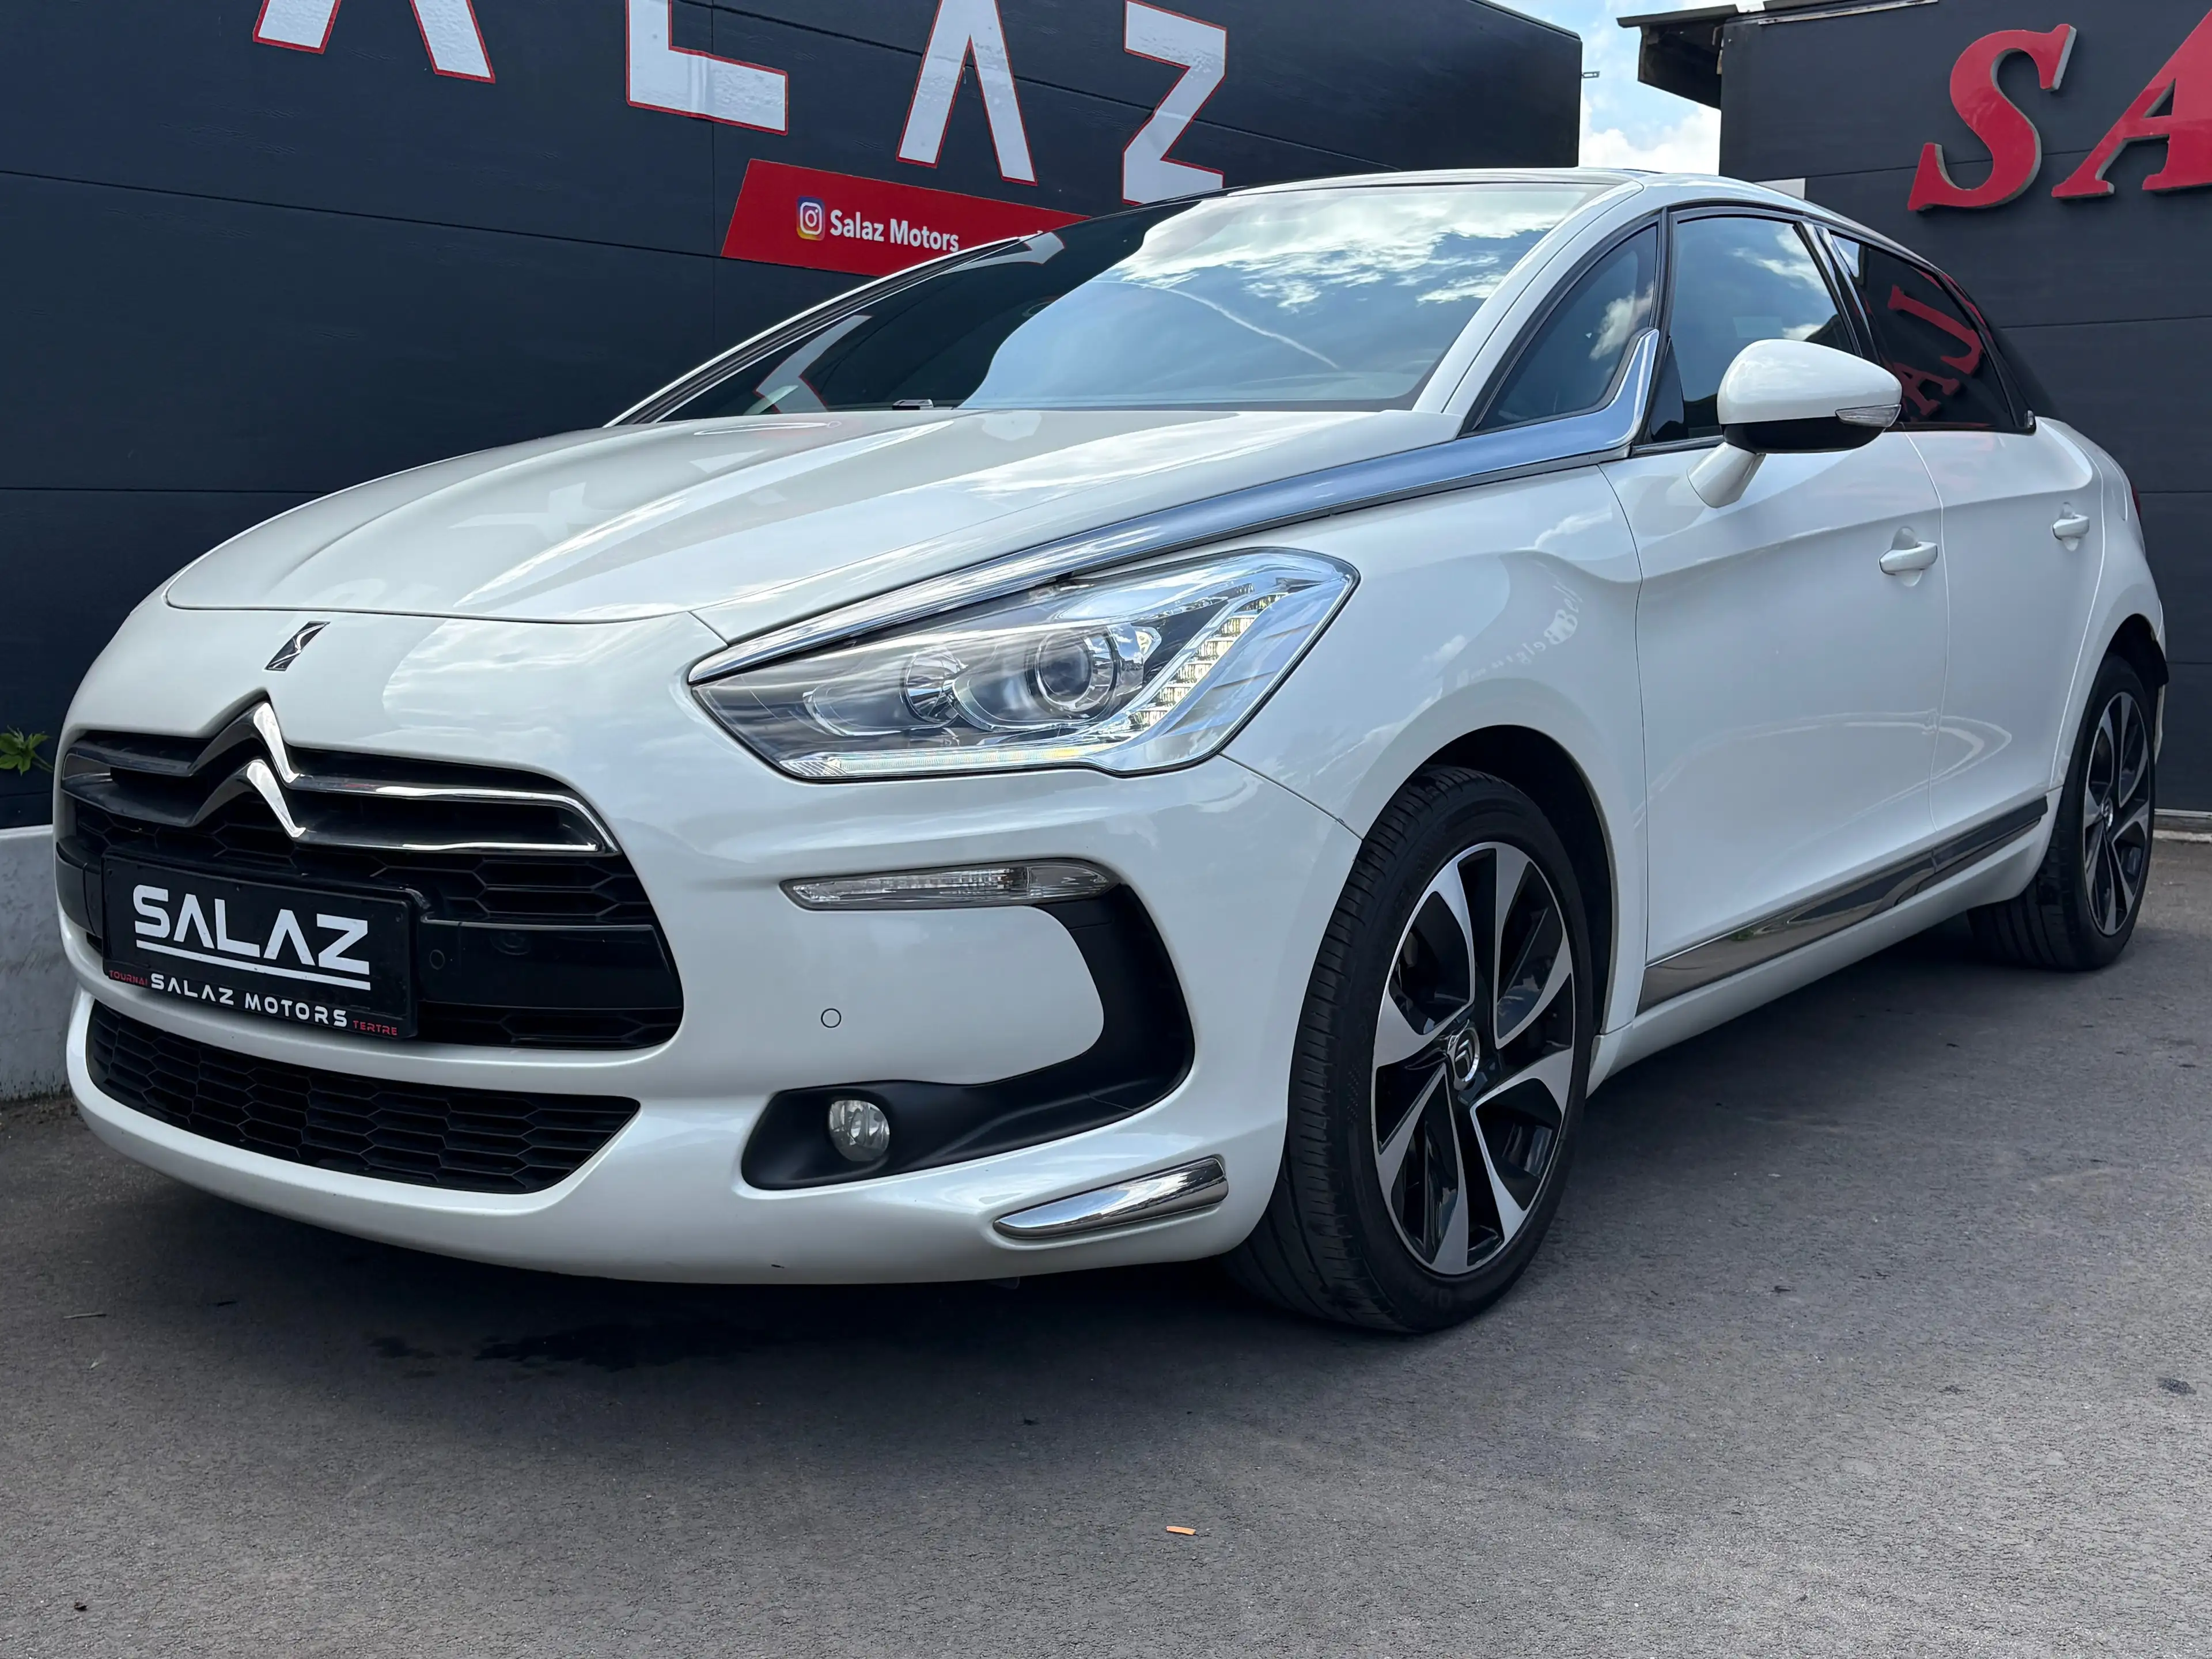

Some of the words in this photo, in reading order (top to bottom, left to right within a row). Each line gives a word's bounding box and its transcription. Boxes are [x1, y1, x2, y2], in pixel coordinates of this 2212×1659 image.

[830, 209, 884, 242] Salaz
[890, 218, 960, 252] Motors
[133, 884, 370, 975] SALAZ
[108, 969, 148, 986] TOURNAI
[151, 973, 234, 1005] SALAZ
[245, 993, 347, 1027] MOTORS
[353, 1020, 398, 1036] TERTRE
